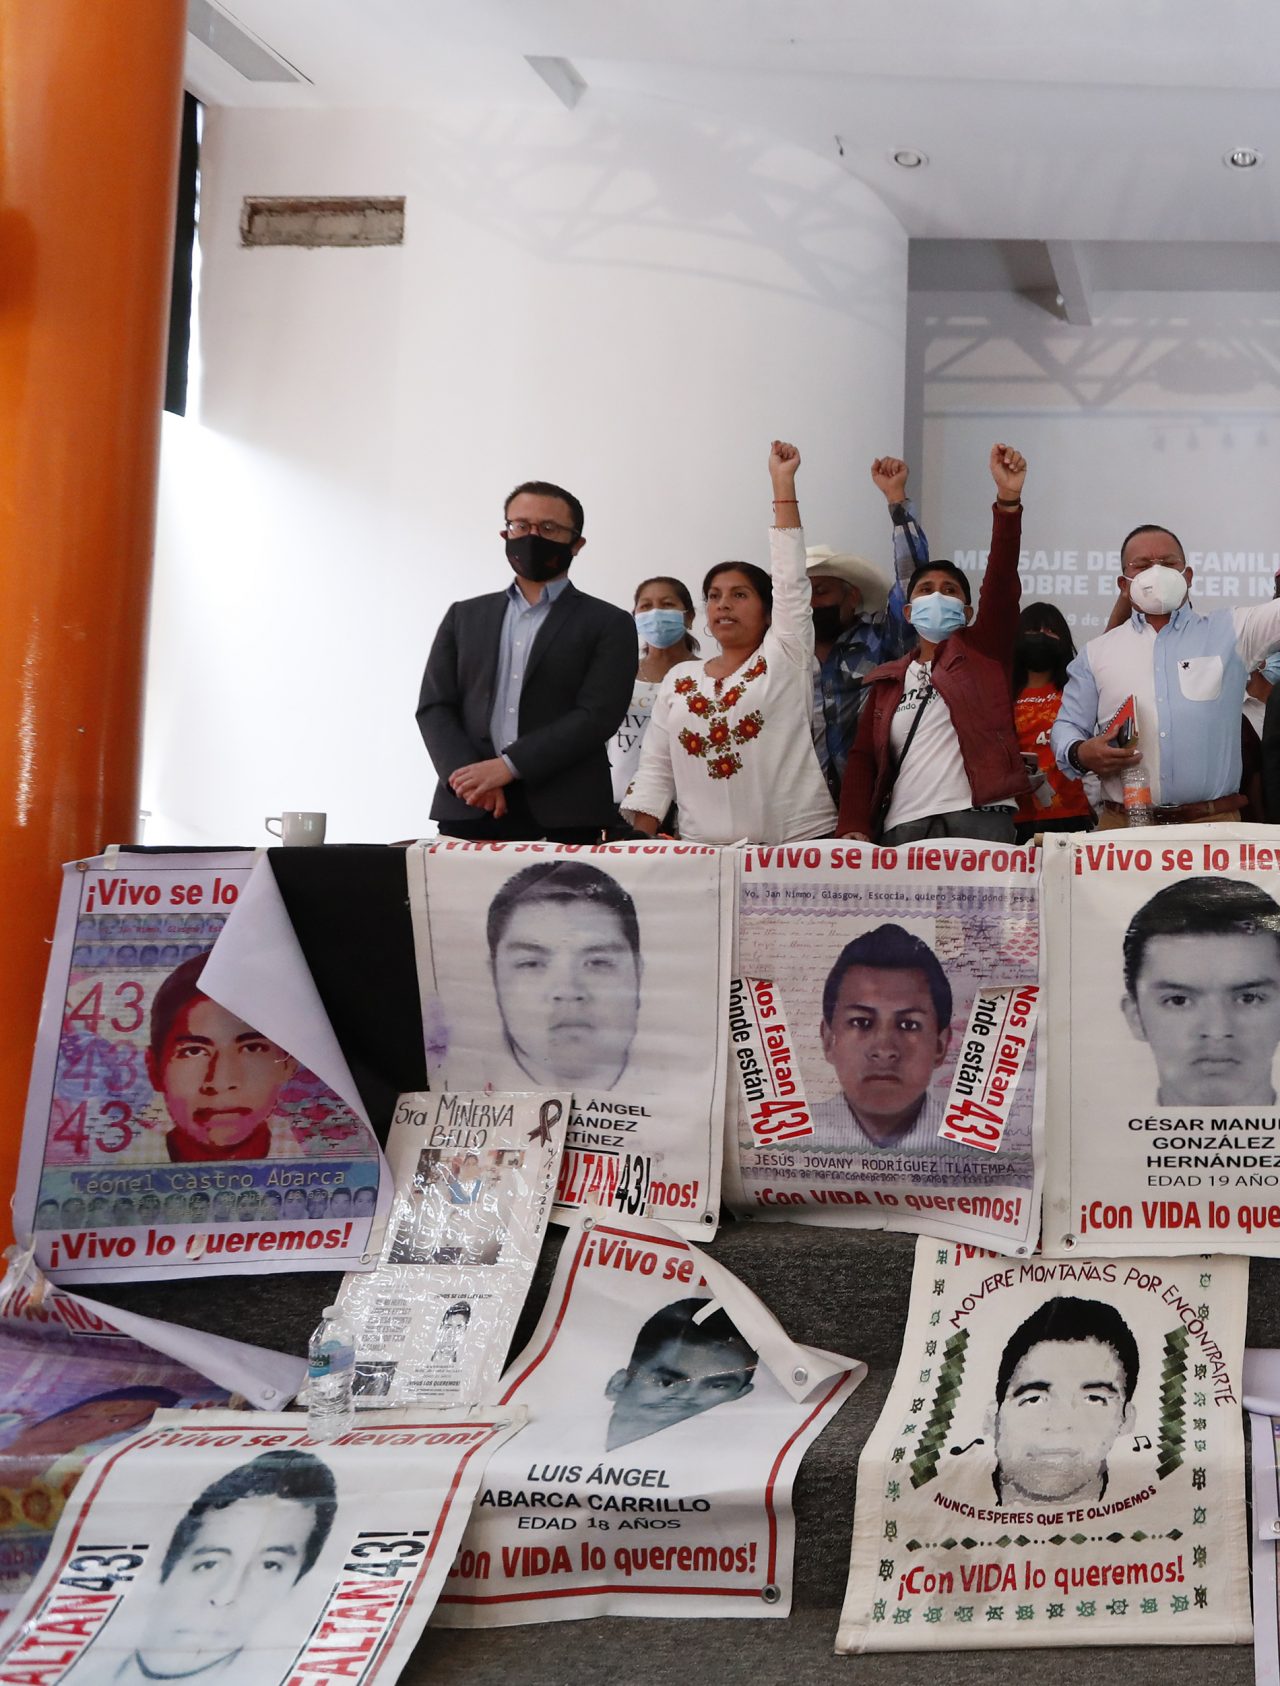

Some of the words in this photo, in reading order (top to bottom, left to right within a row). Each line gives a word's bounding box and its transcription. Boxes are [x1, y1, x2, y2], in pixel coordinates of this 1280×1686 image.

[955, 551, 1079, 572] MESAJE
[744, 847, 822, 872] ¡Vivo
[830, 847, 861, 869] se
[872, 847, 897, 870] lo
[907, 848, 1036, 874] llevaron!
[1074, 843, 1153, 875] ¡Vivo
[1161, 849, 1193, 871] se
[1203, 844, 1229, 871] lo
[85, 879, 160, 912] ¡Vivo
[170, 884, 203, 905] se
[212, 878, 238, 905] lo
[744, 890, 760, 900] Yo,
[765, 889, 781, 899] Jan
[785, 890, 816, 901] Nimmo,
[821, 890, 863, 902] Glasgow,
[868, 892, 909, 902] Escocia,
[914, 893, 946, 902] quiero
[951, 893, 976, 902] saber
[68, 981, 145, 1034] 43
[753, 979, 777, 1019] Nos
[1009, 985, 1040, 1030] Nos
[62, 1040, 138, 1092] 43
[736, 1049, 766, 1102] están
[764, 1024, 796, 1097] faltan
[956, 1040, 986, 1096] están
[988, 1034, 1025, 1108] faltan
[53, 1100, 135, 1154] 43
[395, 1102, 427, 1126] Sra
[435, 1095, 514, 1127] MINERVA
[587, 1099, 651, 1117] ÁNGEL
[751, 1100, 813, 1144] 43!
[944, 1099, 1004, 1152] 43!
[1128, 1116, 1204, 1131] CÉSAR
[429, 1125, 487, 1148] BELLO
[1152, 1134, 1275, 1149] GONZÁLEZ
[74, 1174, 154, 1194] Leonel
[170, 1172, 254, 1190] Castro
[267, 1169, 346, 1186] Abarca
[755, 1152, 795, 1167] JESÚS
[803, 1157, 852, 1168] JOVANY
[862, 1158, 938, 1172] RODRÍGUEZ
[948, 1162, 1015, 1174] TLATEMPA
[1148, 1175, 1201, 1187] EDAD
[1209, 1176, 1230, 1187] 19
[615, 1154, 651, 1216] 43!
[1080, 1201, 1132, 1234] ¡Con
[1141, 1201, 1201, 1229] VIDA
[1208, 1201, 1231, 1228] lo
[50, 1231, 136, 1268] ¡Vivo
[146, 1229, 175, 1256] lo
[185, 1222, 353, 1261] ueremos!
[583, 1237, 655, 1276] ¡Vivo
[662, 1257, 694, 1284] se
[950, 1269, 1015, 1329] MOVERE
[1020, 1262, 1117, 1283] MONTAÑAS
[1123, 1267, 1162, 1294] POR
[1161, 1285, 1237, 1407] ENCONTRARTE
[527, 1463, 583, 1483] LUIS
[586, 1463, 671, 1488] ÁNGEL
[479, 1489, 581, 1508] ABARCA
[587, 1494, 711, 1513] CARRILLO
[934, 1492, 976, 1519] NUNCA
[977, 1509, 1034, 1525] ESPERES
[1036, 1513, 1064, 1526] QUE
[1066, 1511, 1084, 1523] TE
[1087, 1485, 1157, 1520] OLVIDEMOS
[518, 1516, 577, 1530] EDAD
[587, 1516, 610, 1531] 18
[618, 1517, 681, 1530] AÑOS
[60, 1544, 149, 1592] 43!
[343, 1531, 430, 1578] 43!
[501, 1545, 573, 1578] VIDA
[581, 1541, 606, 1571] lo
[614, 1541, 758, 1577] queremos!
[898, 1566, 954, 1601] ¡Con
[959, 1564, 1017, 1594] VIDA
[1024, 1560, 1046, 1590] lo
[1054, 1555, 1184, 1595] queremos!
